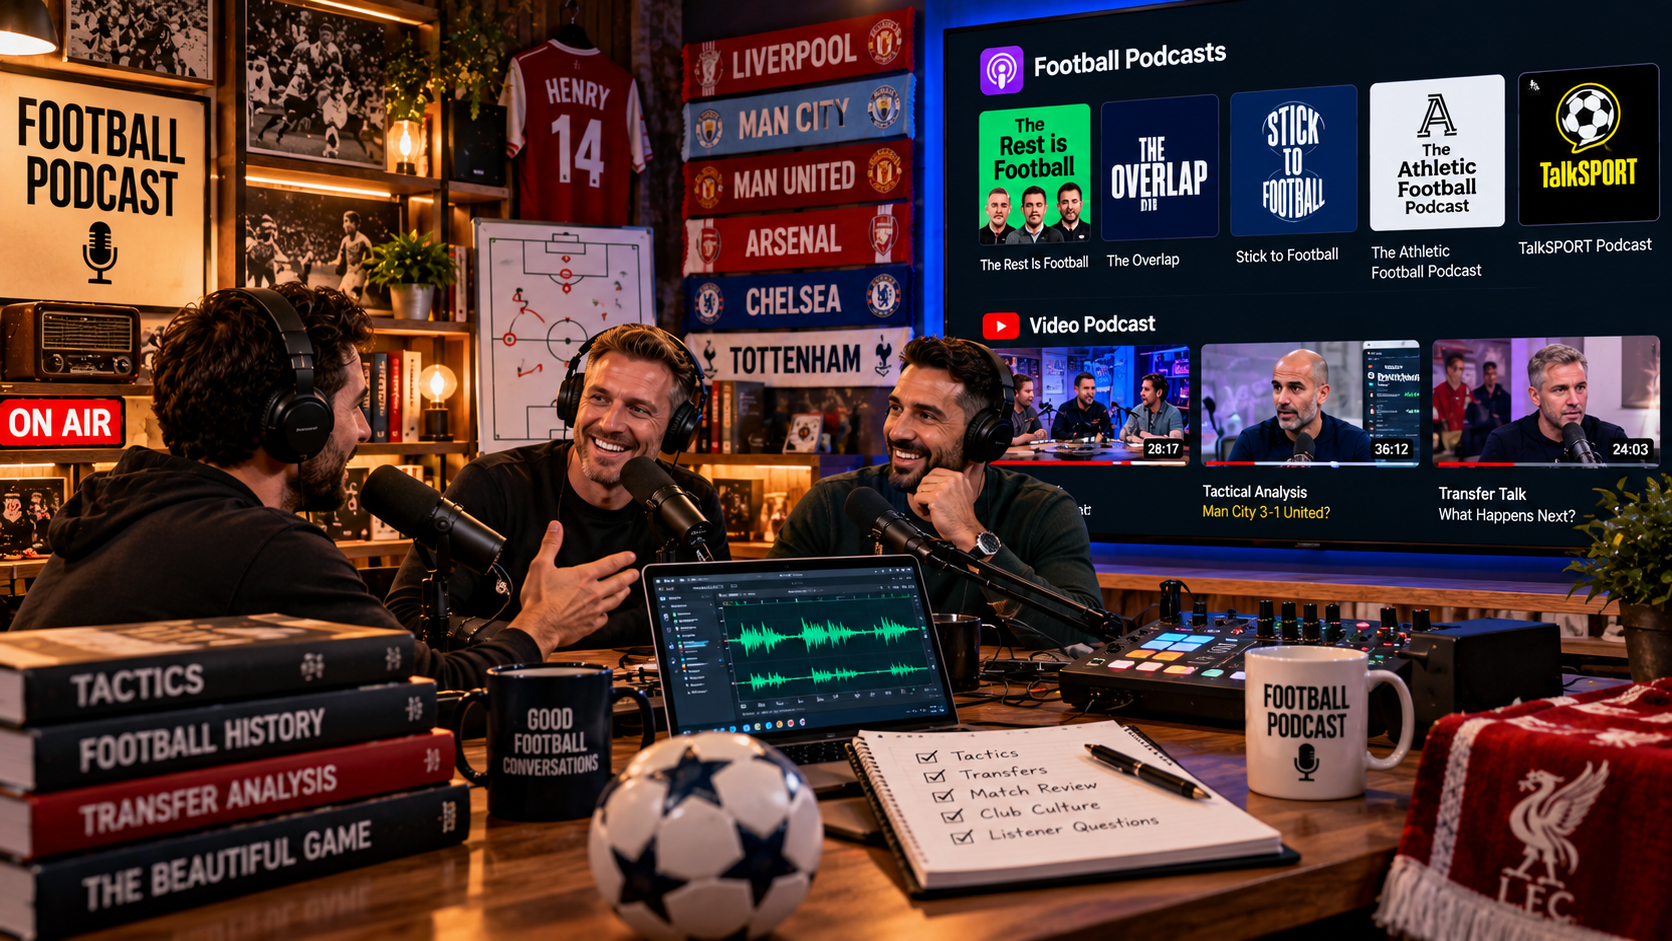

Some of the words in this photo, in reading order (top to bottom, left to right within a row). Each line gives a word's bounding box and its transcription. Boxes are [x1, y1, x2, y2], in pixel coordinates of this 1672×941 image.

[732, 33, 857, 80] LIVERPOOL
[1034, 49, 1119, 76] Football
[1125, 43, 1227, 69] Podcasts
[545, 77, 610, 110] HENRY
[739, 105, 789, 140] MAN
[796, 97, 850, 131] CITY
[1015, 117, 1045, 133] The
[1267, 105, 1320, 147] STICK
[1417, 93, 1457, 138] A
[18, 96, 185, 165] FOOTBALL
[551, 114, 604, 188] 14
[1000, 135, 1045, 156] Rest
[1050, 133, 1068, 152] is
[1139, 136, 1165, 162] THE
[1422, 143, 1451, 157] The
[994, 156, 1075, 180] Football
[1283, 147, 1302, 176] TO
[1397, 157, 1477, 178] Athletic
[1539, 158, 1638, 188] TalkSPORT
[27, 155, 178, 217] PODCAST
[734, 169, 777, 199] MAN
[784, 160, 855, 195] UNITED
[1112, 160, 1208, 199] OVERLAP
[1397, 177, 1477, 198] Football
[1263, 178, 1325, 218] FOOTBALL
[1405, 199, 1470, 214] Podcast
[745, 224, 842, 257] ARSENAL
[1371, 246, 1396, 259] The
[1399, 244, 1450, 258] Athletic
[1518, 239, 1593, 255] TalkSPORT
[1596, 238, 1653, 252] Podcast
[980, 259, 1002, 271] The
[1004, 258, 1029, 270] Rest
[1031, 258, 1041, 270] Is
[1043, 255, 1089, 269] Football
[1107, 254, 1130, 267] The
[1132, 253, 1180, 268] Overlap
[1236, 250, 1267, 263] Stick
[1270, 250, 1284, 262] to
[1287, 247, 1339, 261] Football
[1371, 265, 1424, 279] Football
[1428, 263, 1482, 278] Podcast
[746, 284, 842, 316] CHELSEA
[1029, 316, 1079, 334] Video
[1084, 315, 1156, 333] Podcast
[729, 344, 861, 374] TOTTENHAM
[8, 409, 52, 437] ON
[62, 408, 112, 437] AIR
[1147, 443, 1179, 455] 28:17
[1375, 443, 1409, 456] 36:12
[1612, 443, 1649, 456] 24:03
[1202, 485, 1251, 498] Tactical
[1254, 485, 1308, 501] Analysis
[1439, 487, 1495, 501] Transfer
[1499, 487, 1527, 501] Talk
[1202, 505, 1229, 518] Man
[1231, 505, 1257, 521] City
[1259, 505, 1280, 518] 3-1
[1284, 506, 1331, 519] United?
[1439, 508, 1472, 521] What
[1476, 508, 1534, 525] Happens
[1538, 509, 1577, 523] Next?
[70, 664, 205, 707] TACTICS
[1264, 683, 1350, 711] FOOTBALL
[527, 707, 573, 730] GOOD
[1267, 712, 1347, 739] PODCAST
[79, 723, 218, 773] FOOTBALL
[225, 708, 326, 750] HISTORY
[514, 732, 587, 754] FOOTBALL
[503, 754, 599, 777] CONVERSATIONS
[950, 748, 1019, 762] Tactics
[959, 765, 1048, 780] Transfers
[79, 784, 219, 837] TRANSFER
[226, 764, 337, 810] ANALYSIS
[970, 783, 1029, 800] Match
[1038, 779, 1098, 795] Review
[980, 803, 1022, 820] Club
[1031, 800, 1101, 816] Culture
[989, 824, 1063, 840] Listener
[1073, 815, 1159, 834] Questions
[82, 866, 144, 912] THE
[151, 837, 297, 897] BEAUTIFUL
[303, 820, 372, 862] GAME
